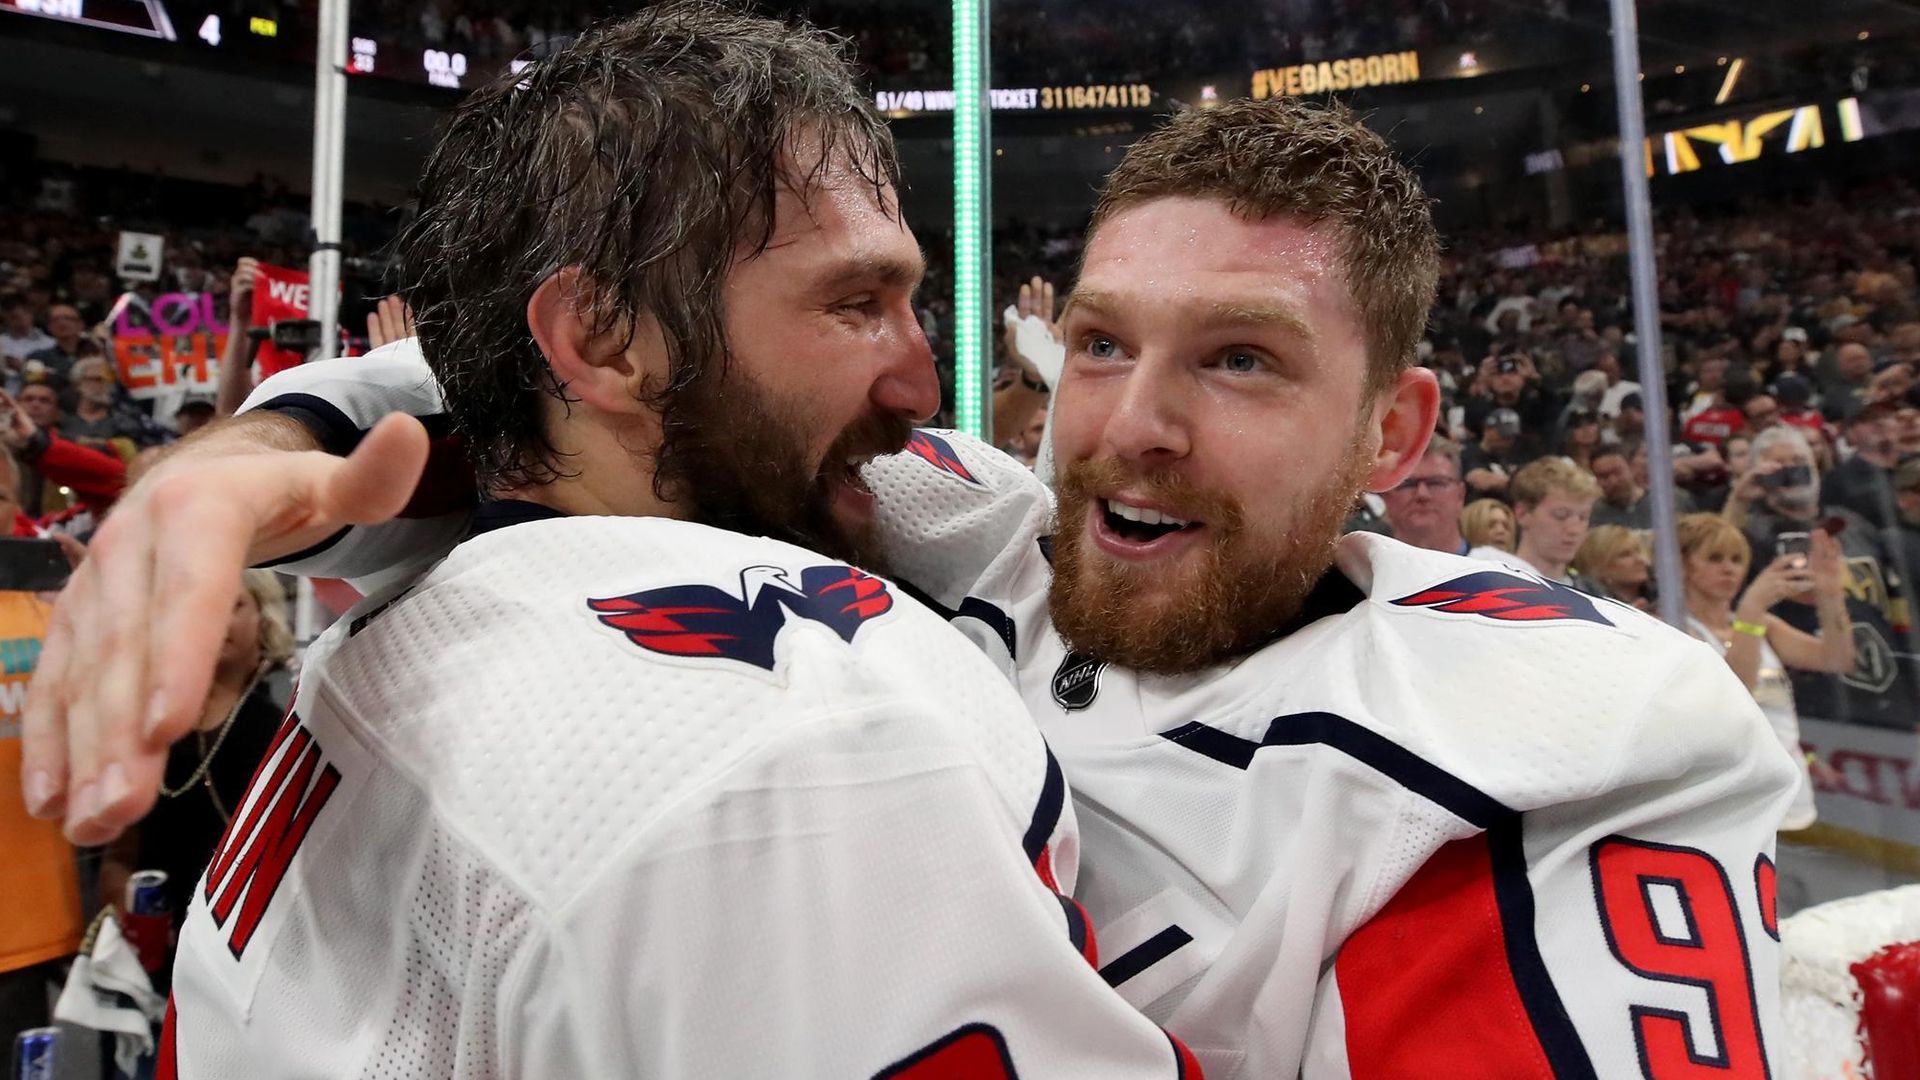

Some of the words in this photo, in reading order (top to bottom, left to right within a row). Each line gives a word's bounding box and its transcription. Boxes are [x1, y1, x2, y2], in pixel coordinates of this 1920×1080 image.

[198, 14, 222, 46] 4
[1251, 51, 1420, 101] #VEGASBORN
[1058, 664, 1095, 692] NHL
[1589, 834, 1780, 1080] 9
